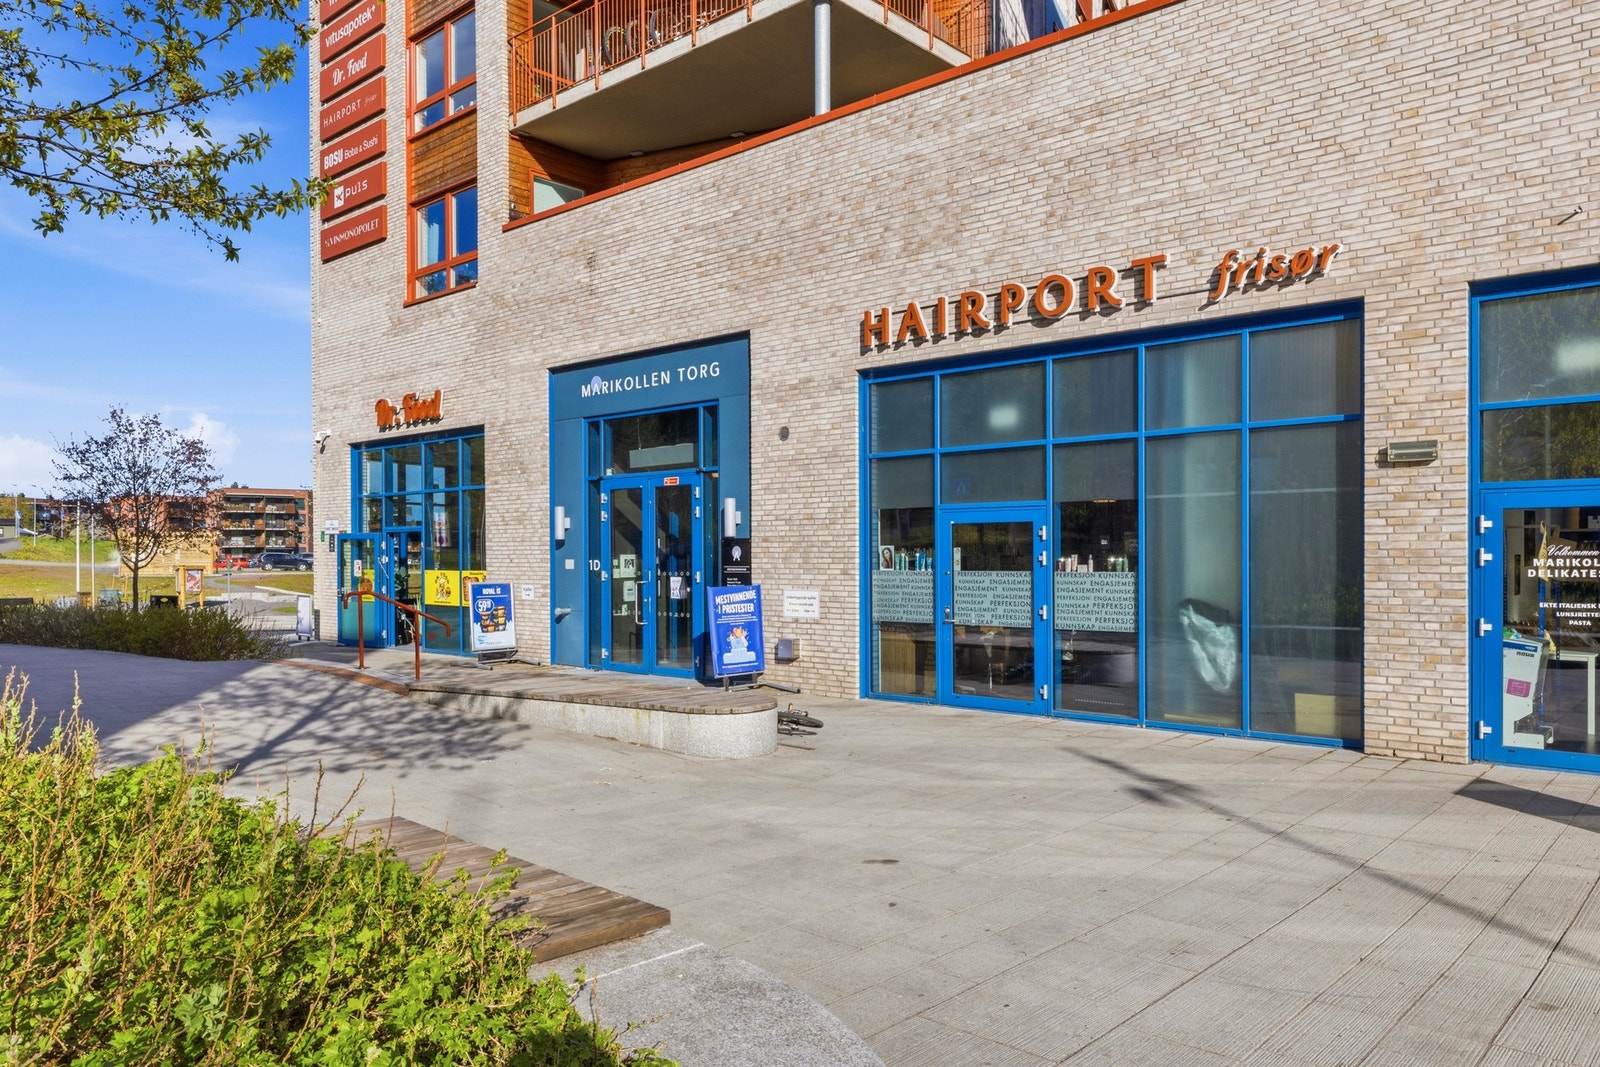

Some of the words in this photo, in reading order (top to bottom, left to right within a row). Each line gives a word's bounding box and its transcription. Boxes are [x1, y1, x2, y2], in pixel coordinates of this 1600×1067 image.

[332, 68, 346, 86] Dr.
[347, 51, 368, 77] Food
[323, 98, 362, 128] HAIRPORT
[324, 148, 343, 170] BOSU
[344, 147, 358, 160] Boba
[363, 134, 378, 150] Sushi
[345, 180, 368, 198] puls
[328, 218, 379, 246] VINMONOPOLET
[863, 254, 1168, 348] HAIRPORT
[1208, 243, 1341, 301] frisør
[581, 370, 670, 398] MARIKOLLEN
[678, 362, 720, 382] TORG
[374, 398, 401, 427] Dr.
[402, 389, 442, 422] Food
[1546, 544, 1600, 557] Velkommen
[588, 560, 600, 571] 1D
[1527, 569, 1600, 578] DELIKATE
[1533, 558, 1600, 567] MARIKOL
[716, 590, 756, 605] MESTVINNENDE
[722, 603, 754, 614] PRISTESTER
